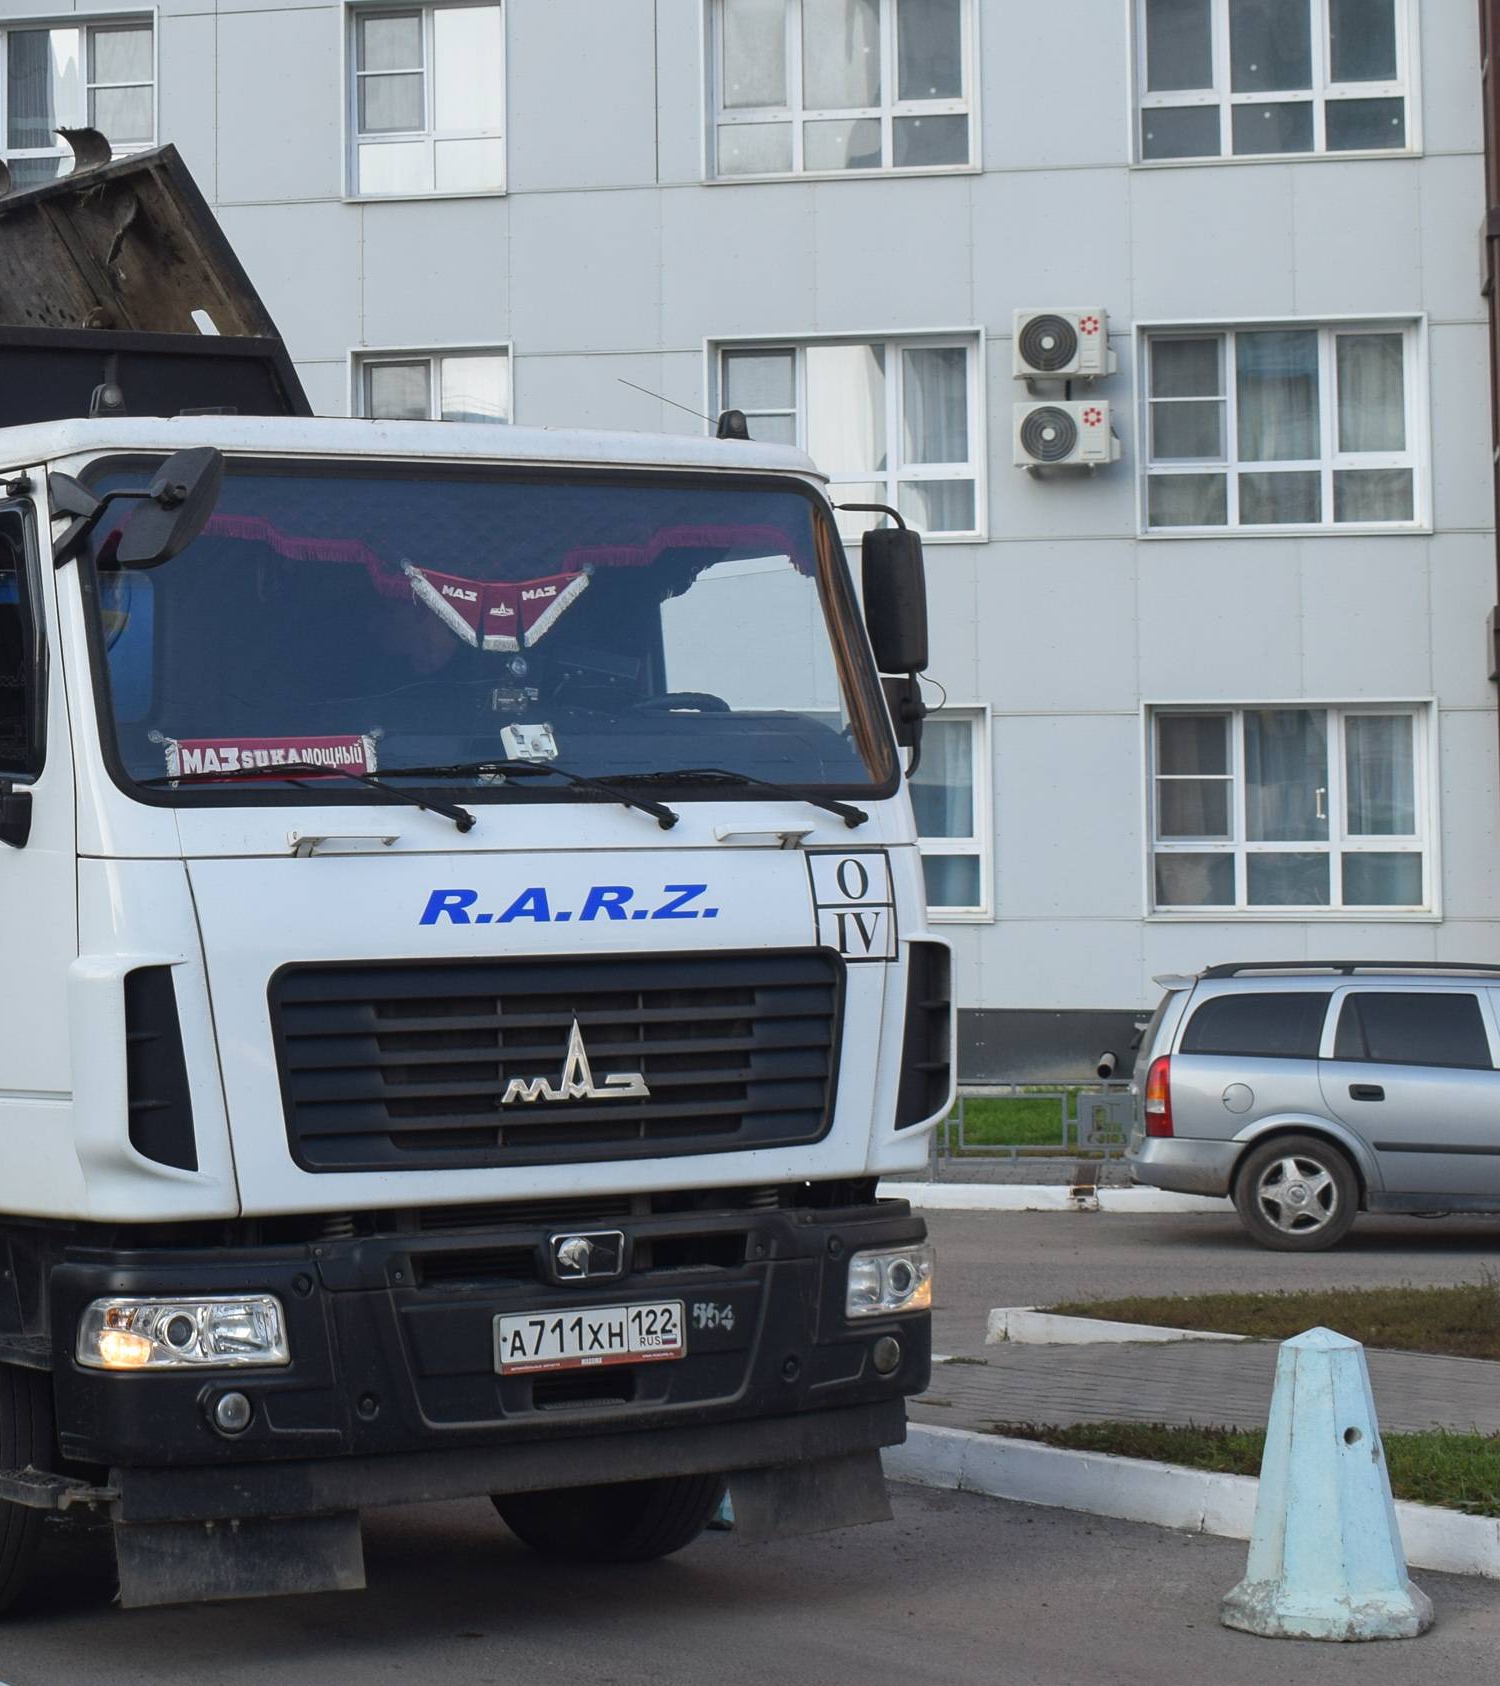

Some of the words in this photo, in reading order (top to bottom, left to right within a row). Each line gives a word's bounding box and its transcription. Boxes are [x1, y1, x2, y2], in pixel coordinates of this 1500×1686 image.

[442, 584, 478, 602] МАЗ
[521, 585, 557, 601] МАЗ
[182, 747, 239, 776] МАЗ
[418, 883, 720, 926] R.A.R.Z.
[832, 911, 881, 954] IV
[501, 1017, 651, 1103] МАЗ
[509, 1315, 624, 1358] А711ХН
[630, 1307, 674, 1337] 122
[639, 1335, 662, 1347] RUS
